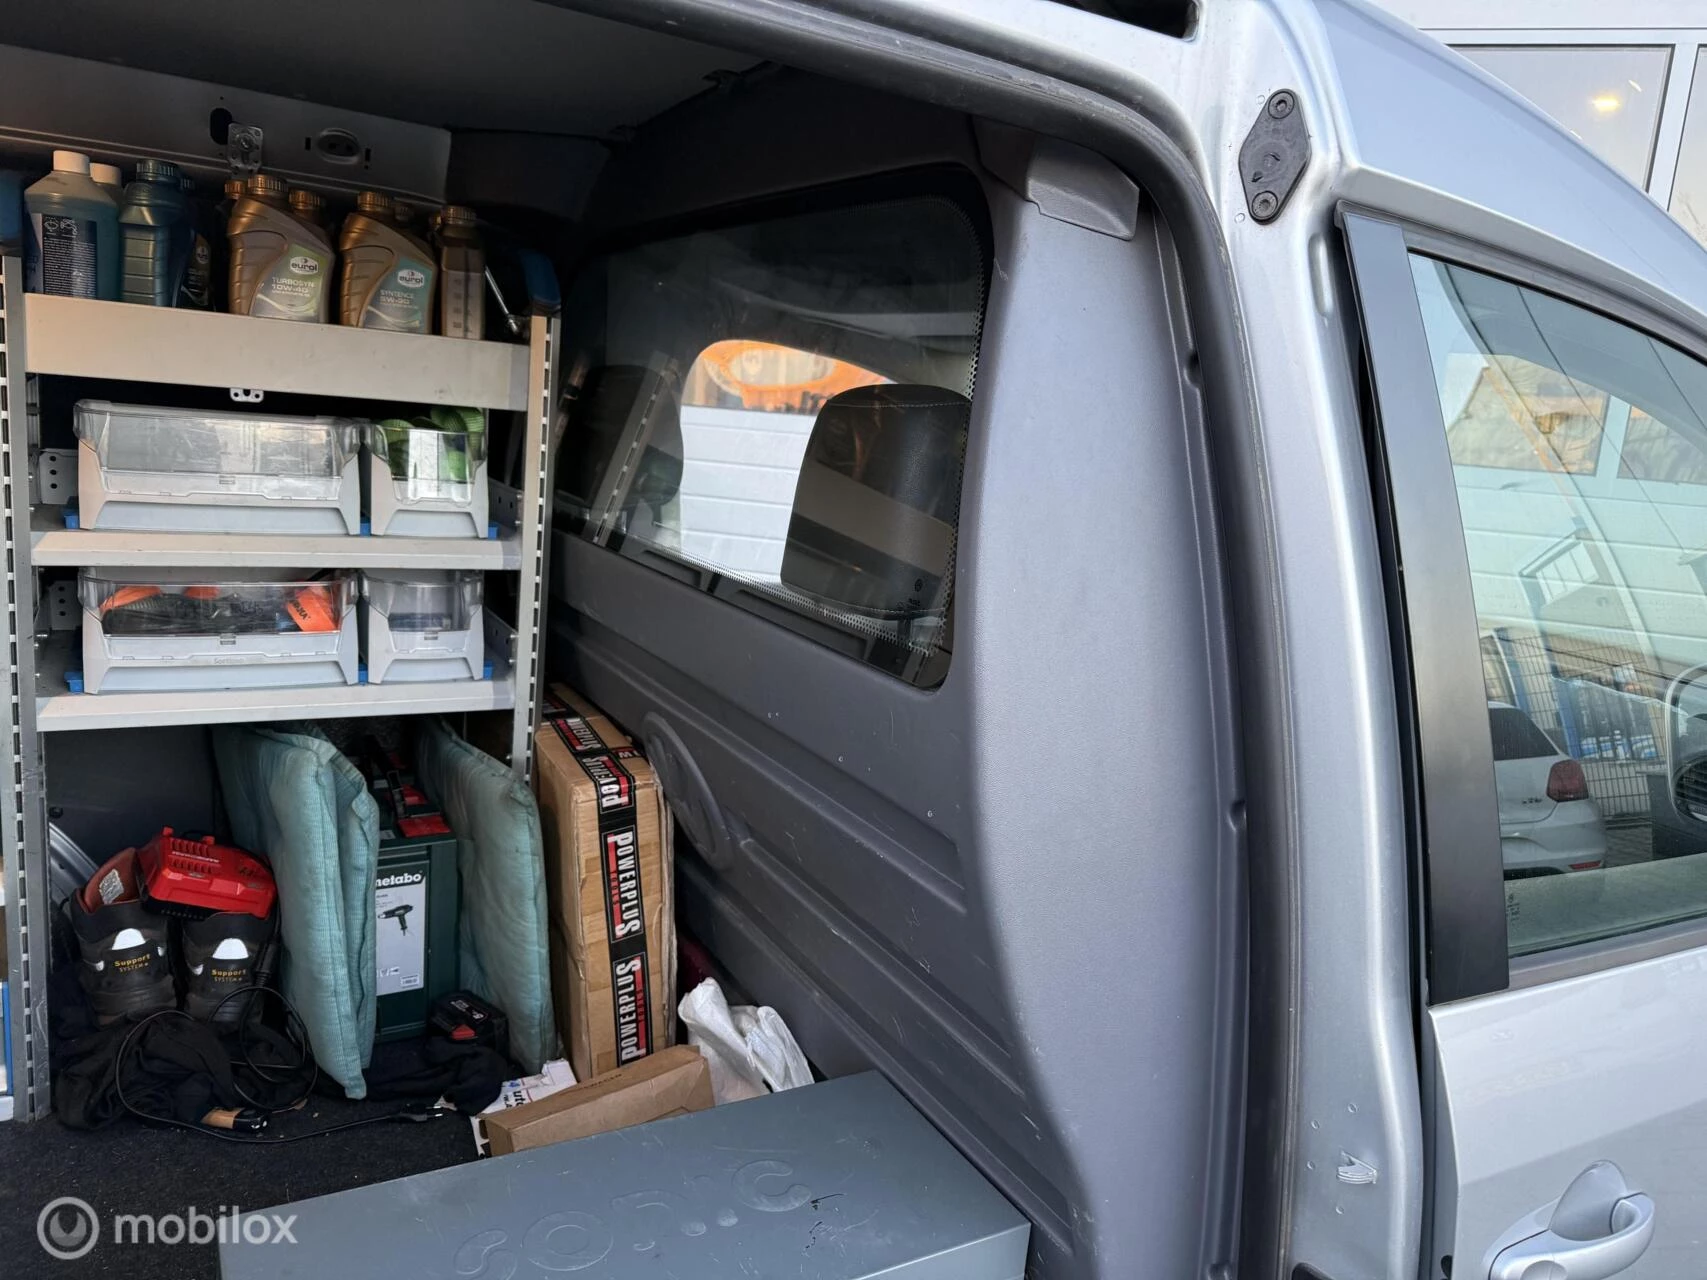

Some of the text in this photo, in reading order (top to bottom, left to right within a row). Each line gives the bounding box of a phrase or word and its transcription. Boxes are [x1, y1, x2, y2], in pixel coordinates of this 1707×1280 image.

[290, 262, 318, 272] eurol
[399, 275, 424, 284] eurol
[607, 831, 641, 937] POWERPLUS
[113, 953, 151, 968] Support
[211, 968, 247, 978] Support
[616, 959, 647, 1061] POWERPLUS
